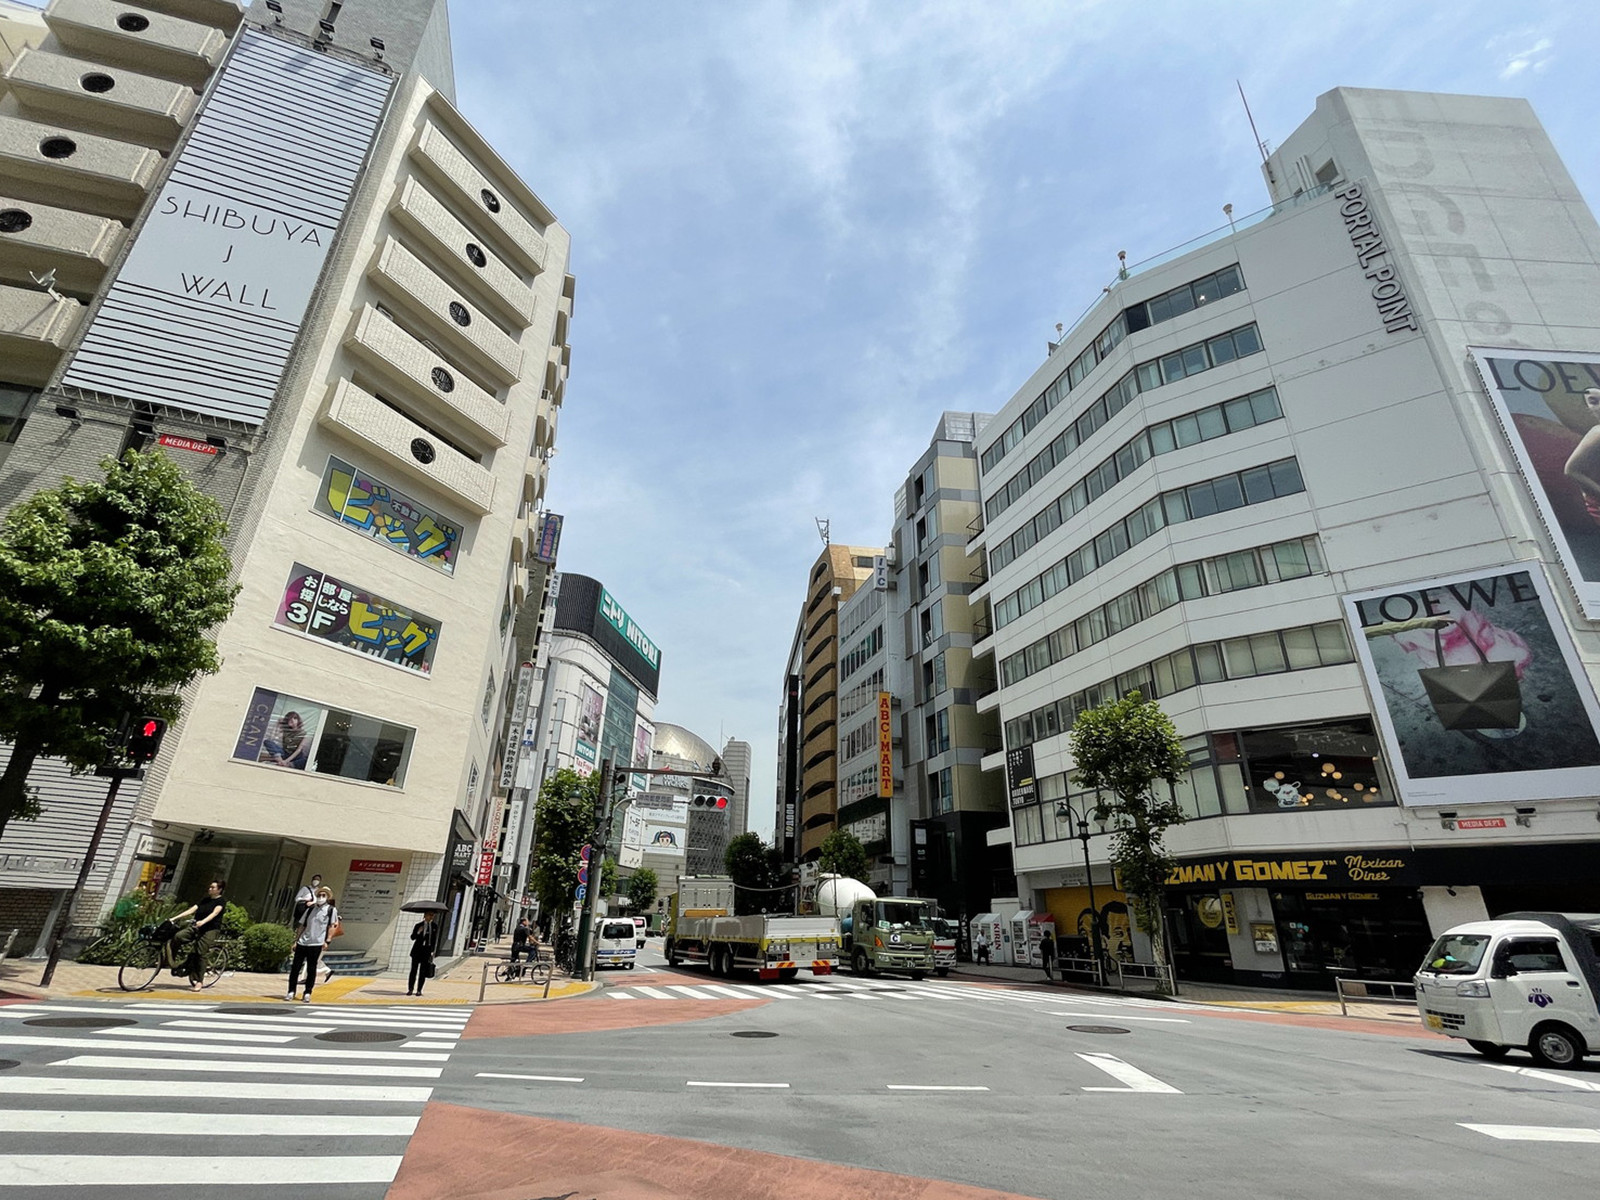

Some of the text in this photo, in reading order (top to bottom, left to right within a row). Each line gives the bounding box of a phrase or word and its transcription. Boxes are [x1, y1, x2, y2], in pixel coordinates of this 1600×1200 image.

[160, 196, 321, 247] SHIBUYA
[222, 245, 233, 263] J
[1335, 182, 1418, 334] PORTAL POINT
[181, 272, 277, 310] WALL
[1483, 357, 1600, 394] LOE
[164, 437, 190, 448] MEDIA
[327, 467, 458, 558] ビッグ
[877, 558, 886, 586] ITC
[299, 587, 349, 615] 探しなら
[303, 575, 352, 603] お部屋
[1353, 571, 1540, 628] LOEWE
[286, 602, 336, 630] 3F
[348, 600, 437, 657] ビッグ
[602, 593, 658, 665] ニトリ NITORI
[880, 698, 891, 790] ABC-MART
[1461, 821, 1483, 829] MEDIA
[455, 844, 472, 853] ABC
[1344, 856, 1405, 869] Mexican
[1216, 861, 1229, 881] Y
[993, 923, 1001, 951] KIRIN
